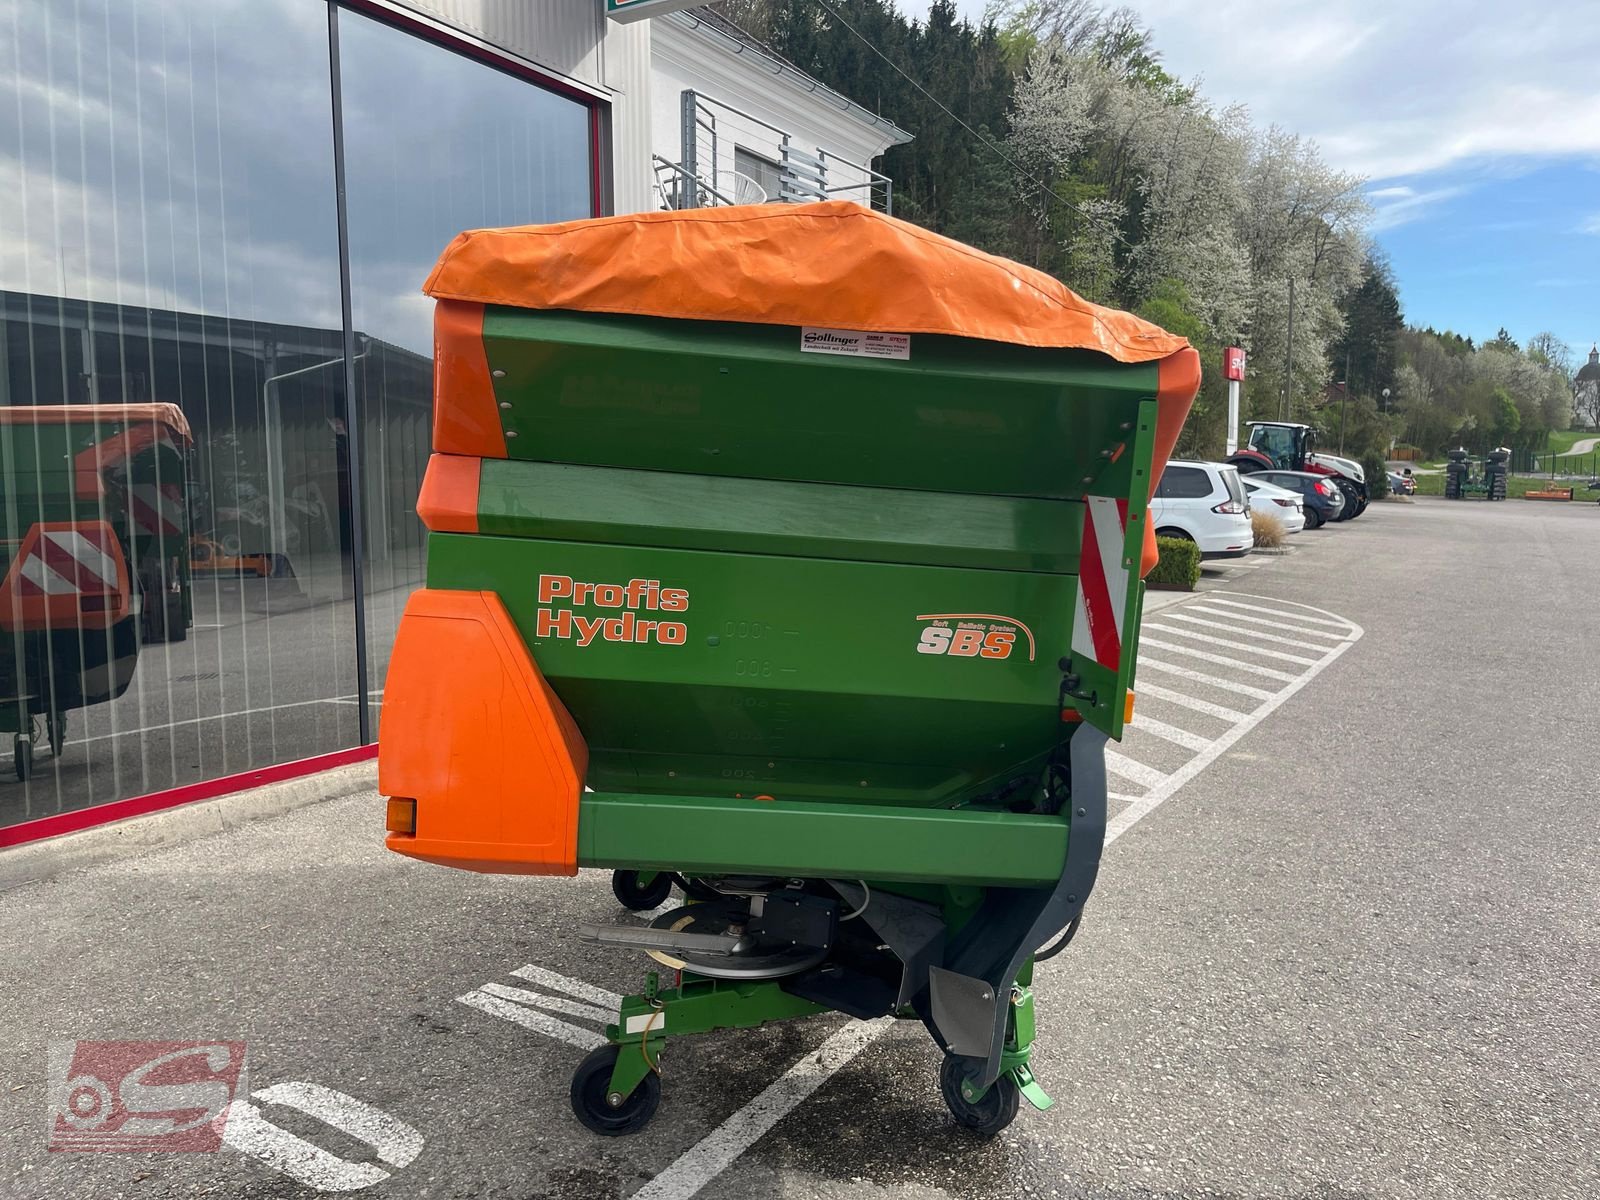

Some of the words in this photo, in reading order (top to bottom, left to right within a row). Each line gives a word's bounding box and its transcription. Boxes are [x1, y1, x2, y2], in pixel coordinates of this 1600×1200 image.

[538, 574, 689, 612] Profis
[536, 608, 688, 647] Hydro
[916, 626, 1017, 660] SBS
[932, 620, 949, 628] Soft
[957, 621, 986, 631] Ballistic
[989, 624, 1017, 633] System
